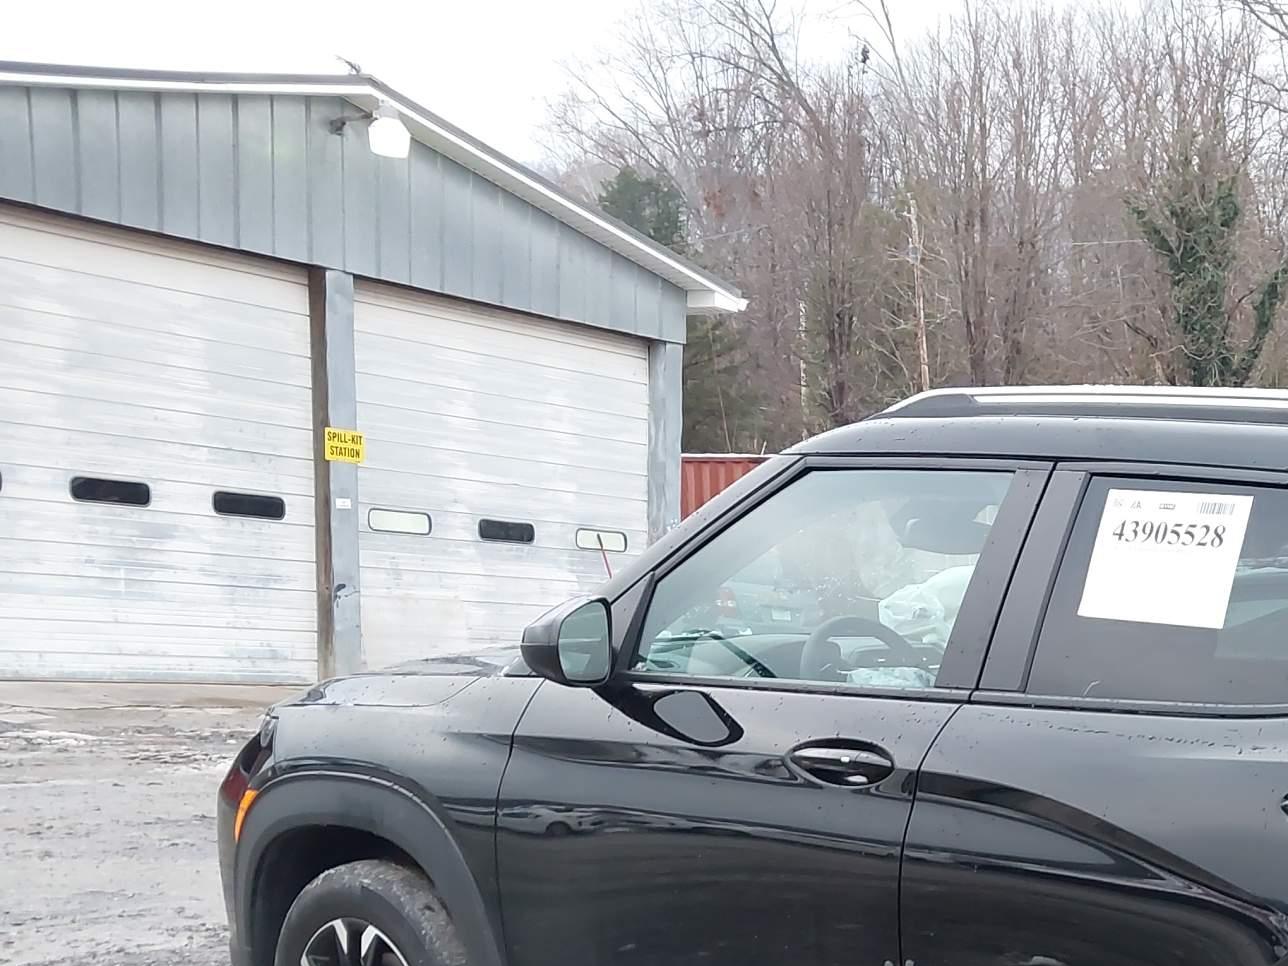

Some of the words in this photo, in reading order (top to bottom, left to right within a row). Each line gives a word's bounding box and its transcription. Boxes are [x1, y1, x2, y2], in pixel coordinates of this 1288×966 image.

[327, 431, 363, 445] SPILL-KIT
[329, 445, 361, 459] STATION
[1112, 519, 1227, 549] 43905528
